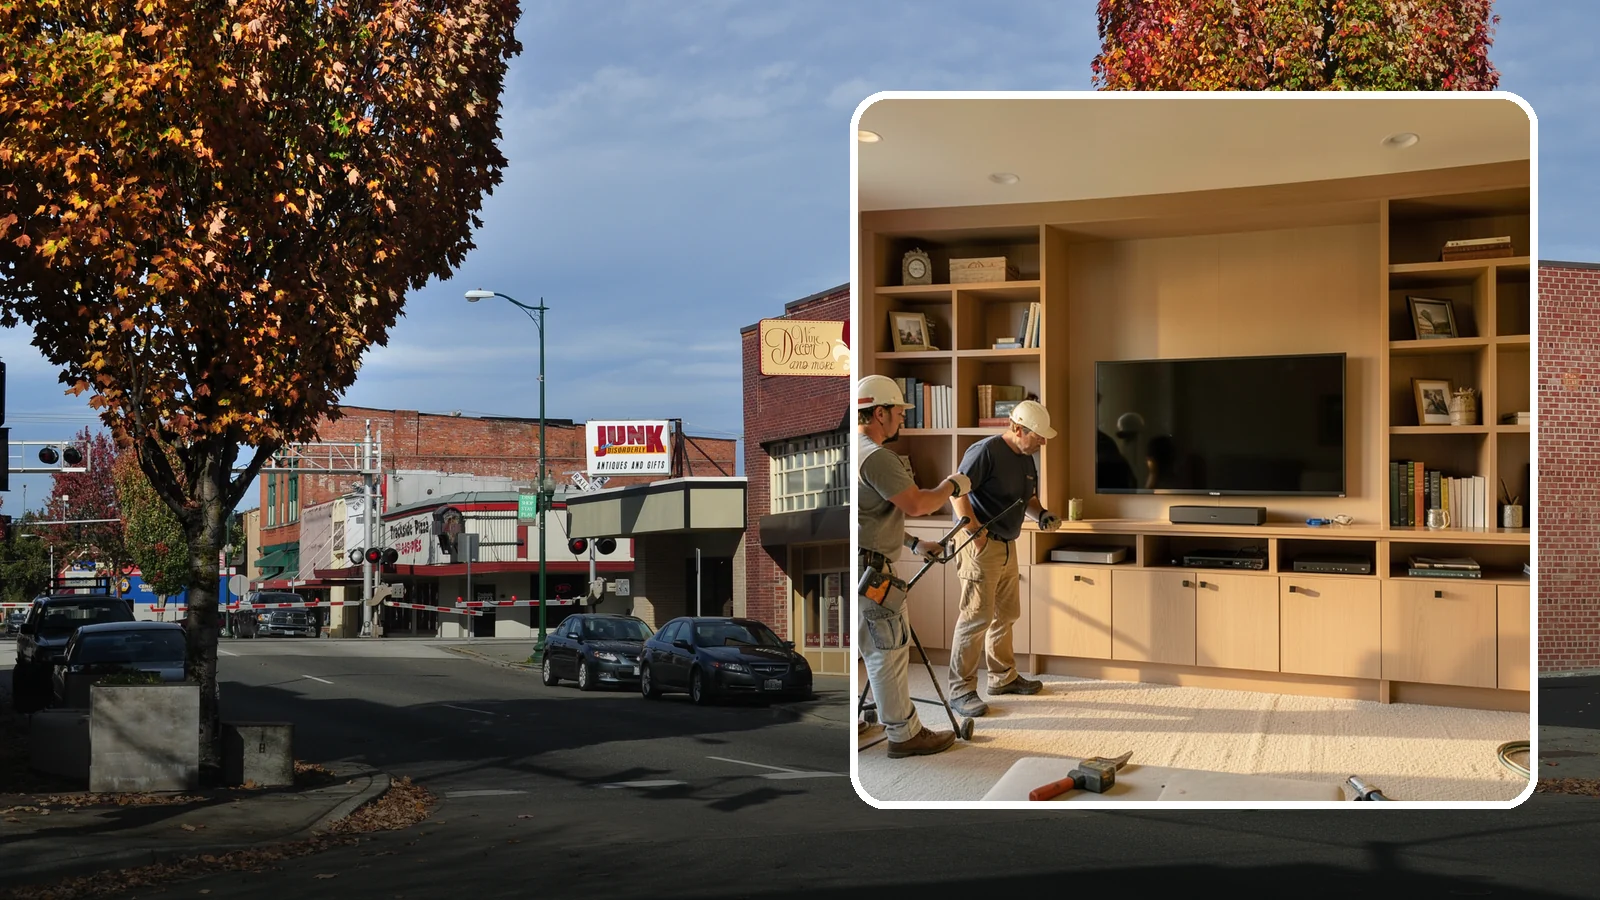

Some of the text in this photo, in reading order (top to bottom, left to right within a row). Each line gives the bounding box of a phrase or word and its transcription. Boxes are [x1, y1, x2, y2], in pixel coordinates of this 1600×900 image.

[595, 425, 665, 457] JUNK
[607, 446, 646, 454] DISORDERLY
[597, 460, 665, 470] ANTIQUES AND GIFTS
[414, 519, 429, 535] Pizza
